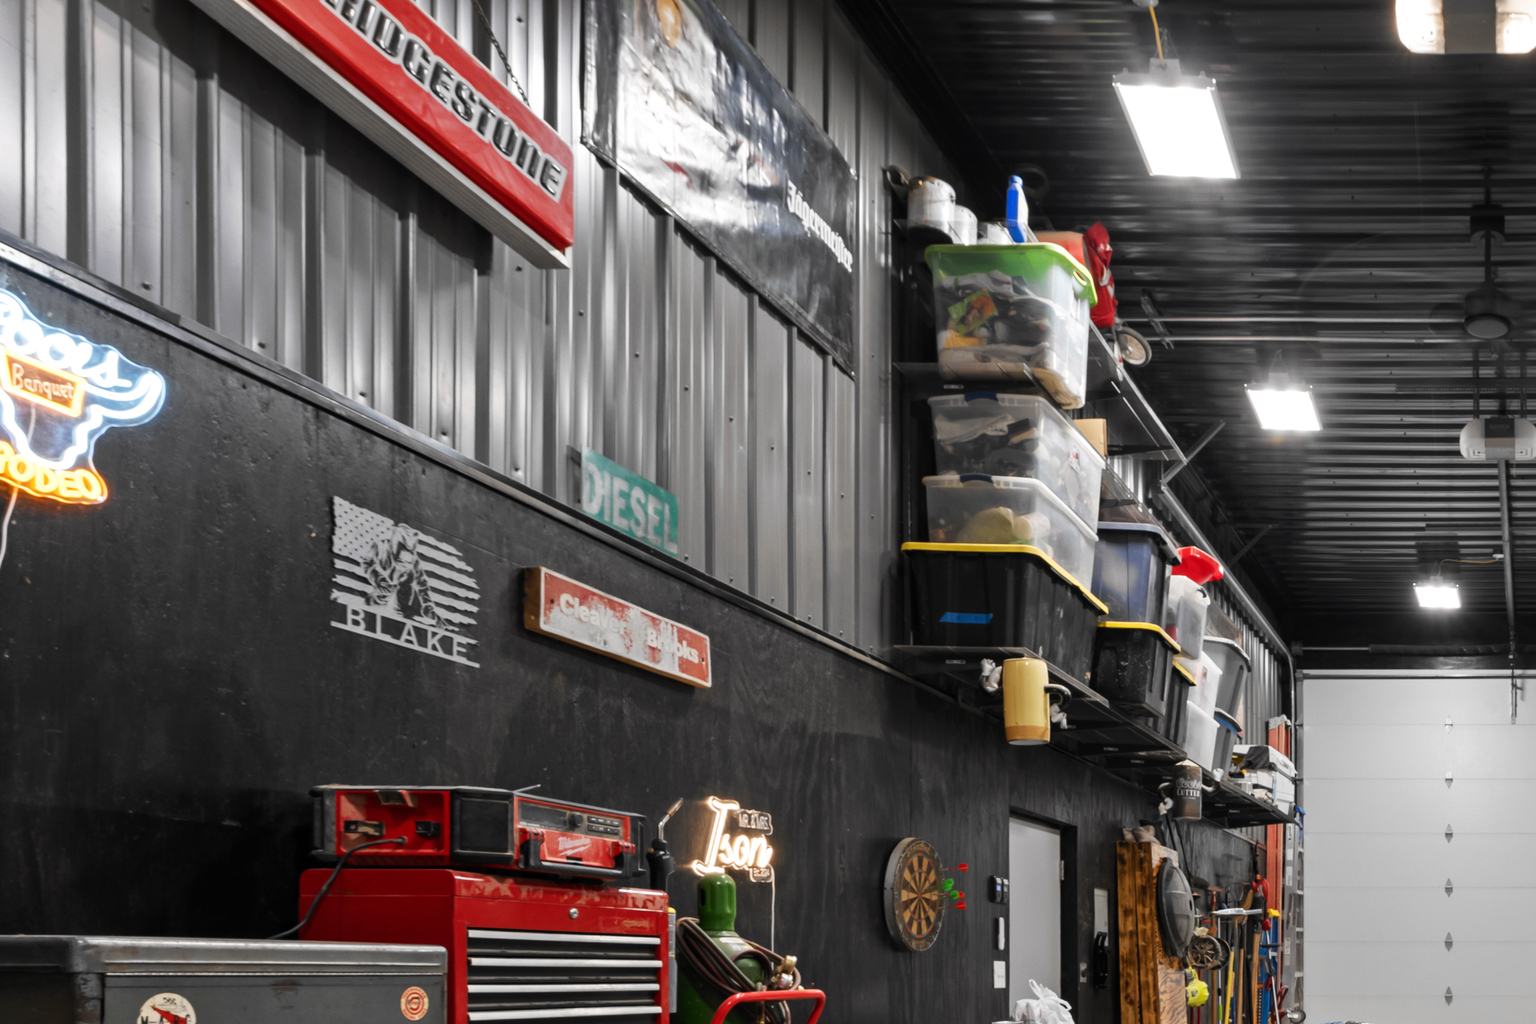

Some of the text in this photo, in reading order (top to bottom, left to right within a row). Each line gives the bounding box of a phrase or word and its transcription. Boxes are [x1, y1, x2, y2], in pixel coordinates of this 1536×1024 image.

[0, 294, 132, 388] oors
[11, 362, 75, 401] Banquet
[582, 460, 678, 554] DIESEL
[345, 605, 468, 662] BLAKE
[560, 593, 627, 635] Cleaver
[696, 799, 773, 874] Ison
